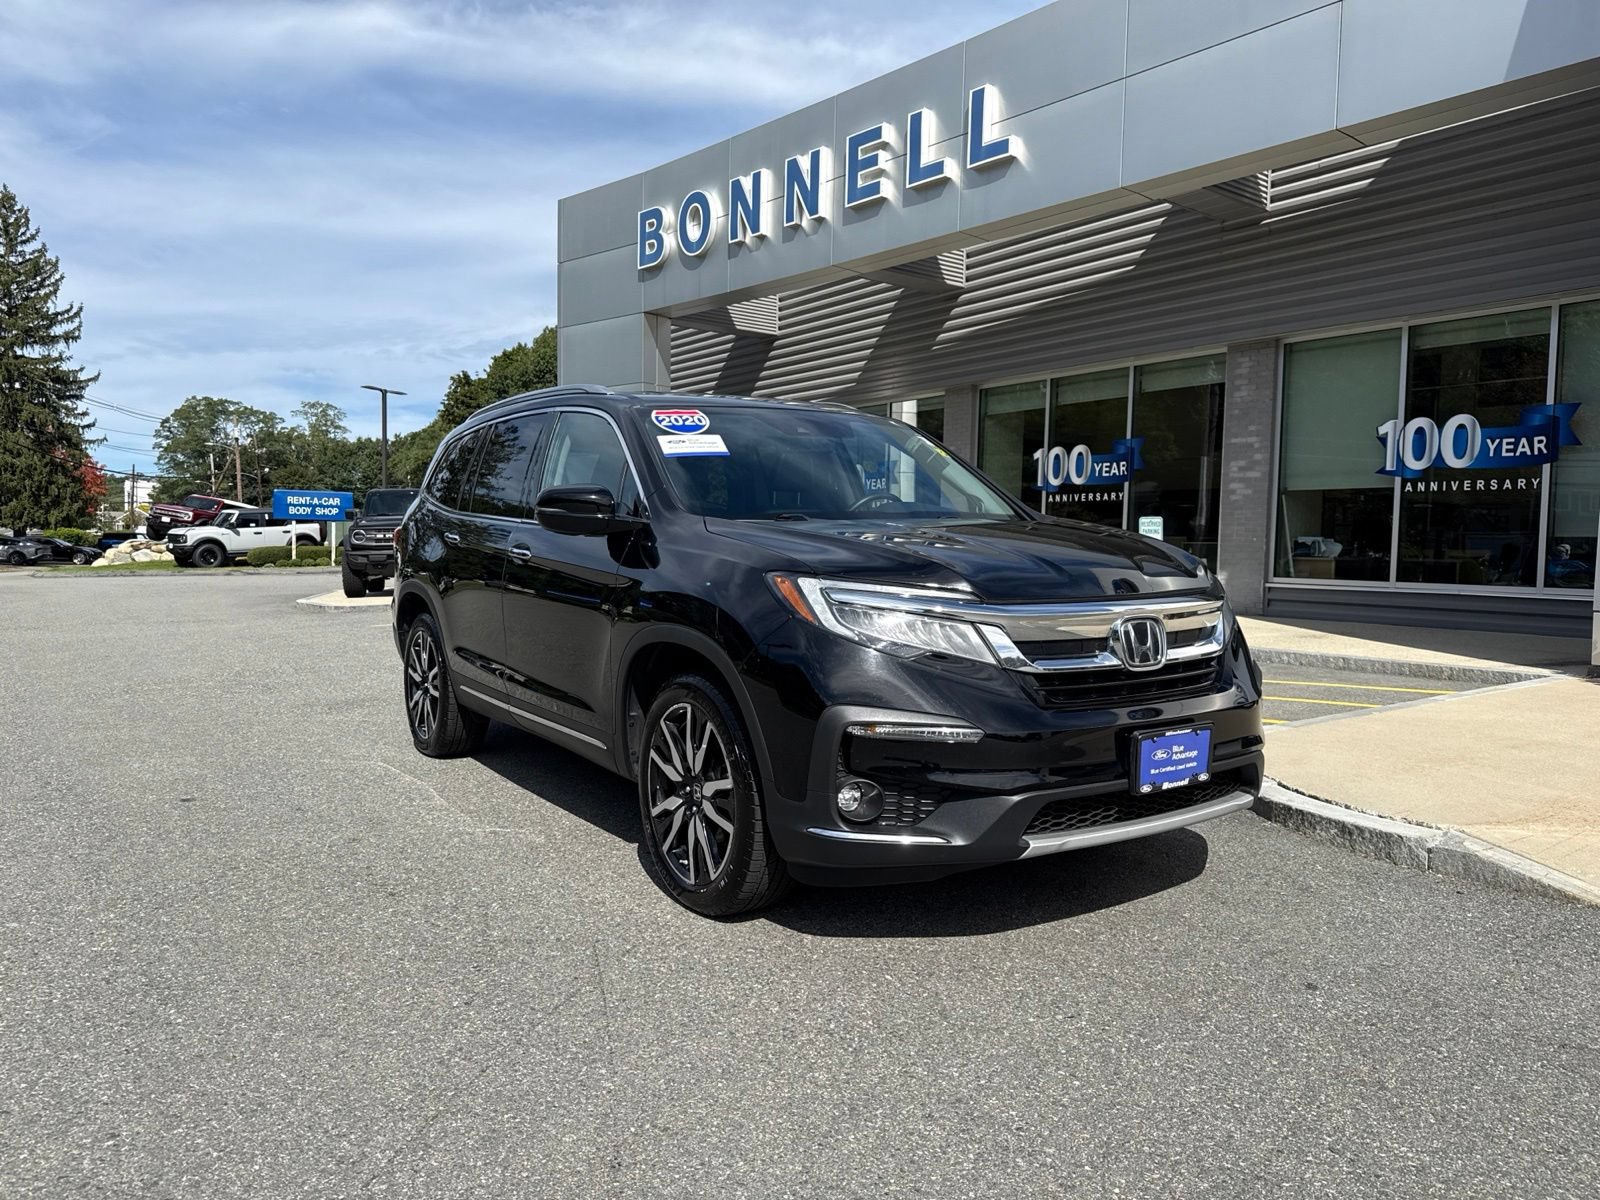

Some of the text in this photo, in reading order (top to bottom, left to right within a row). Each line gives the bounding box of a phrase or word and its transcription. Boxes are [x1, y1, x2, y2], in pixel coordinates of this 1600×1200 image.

[637, 84, 1018, 270] BONNELL
[658, 415, 706, 426] 2020
[1376, 413, 1548, 471] 100 YEAR
[1032, 444, 1128, 486] 100 YEAR
[866, 478, 887, 490] YEAR
[1404, 477, 1542, 493] ANNIVERSARY
[286, 495, 341, 506] RENT-A-CAR
[1047, 491, 1125, 503] ANNIVERSARY
[288, 506, 339, 516] BODY SHOP
[1172, 745, 1184, 753] Blue
[1172, 750, 1198, 760] Advantage
[1162, 777, 1190, 790] Bonnell
